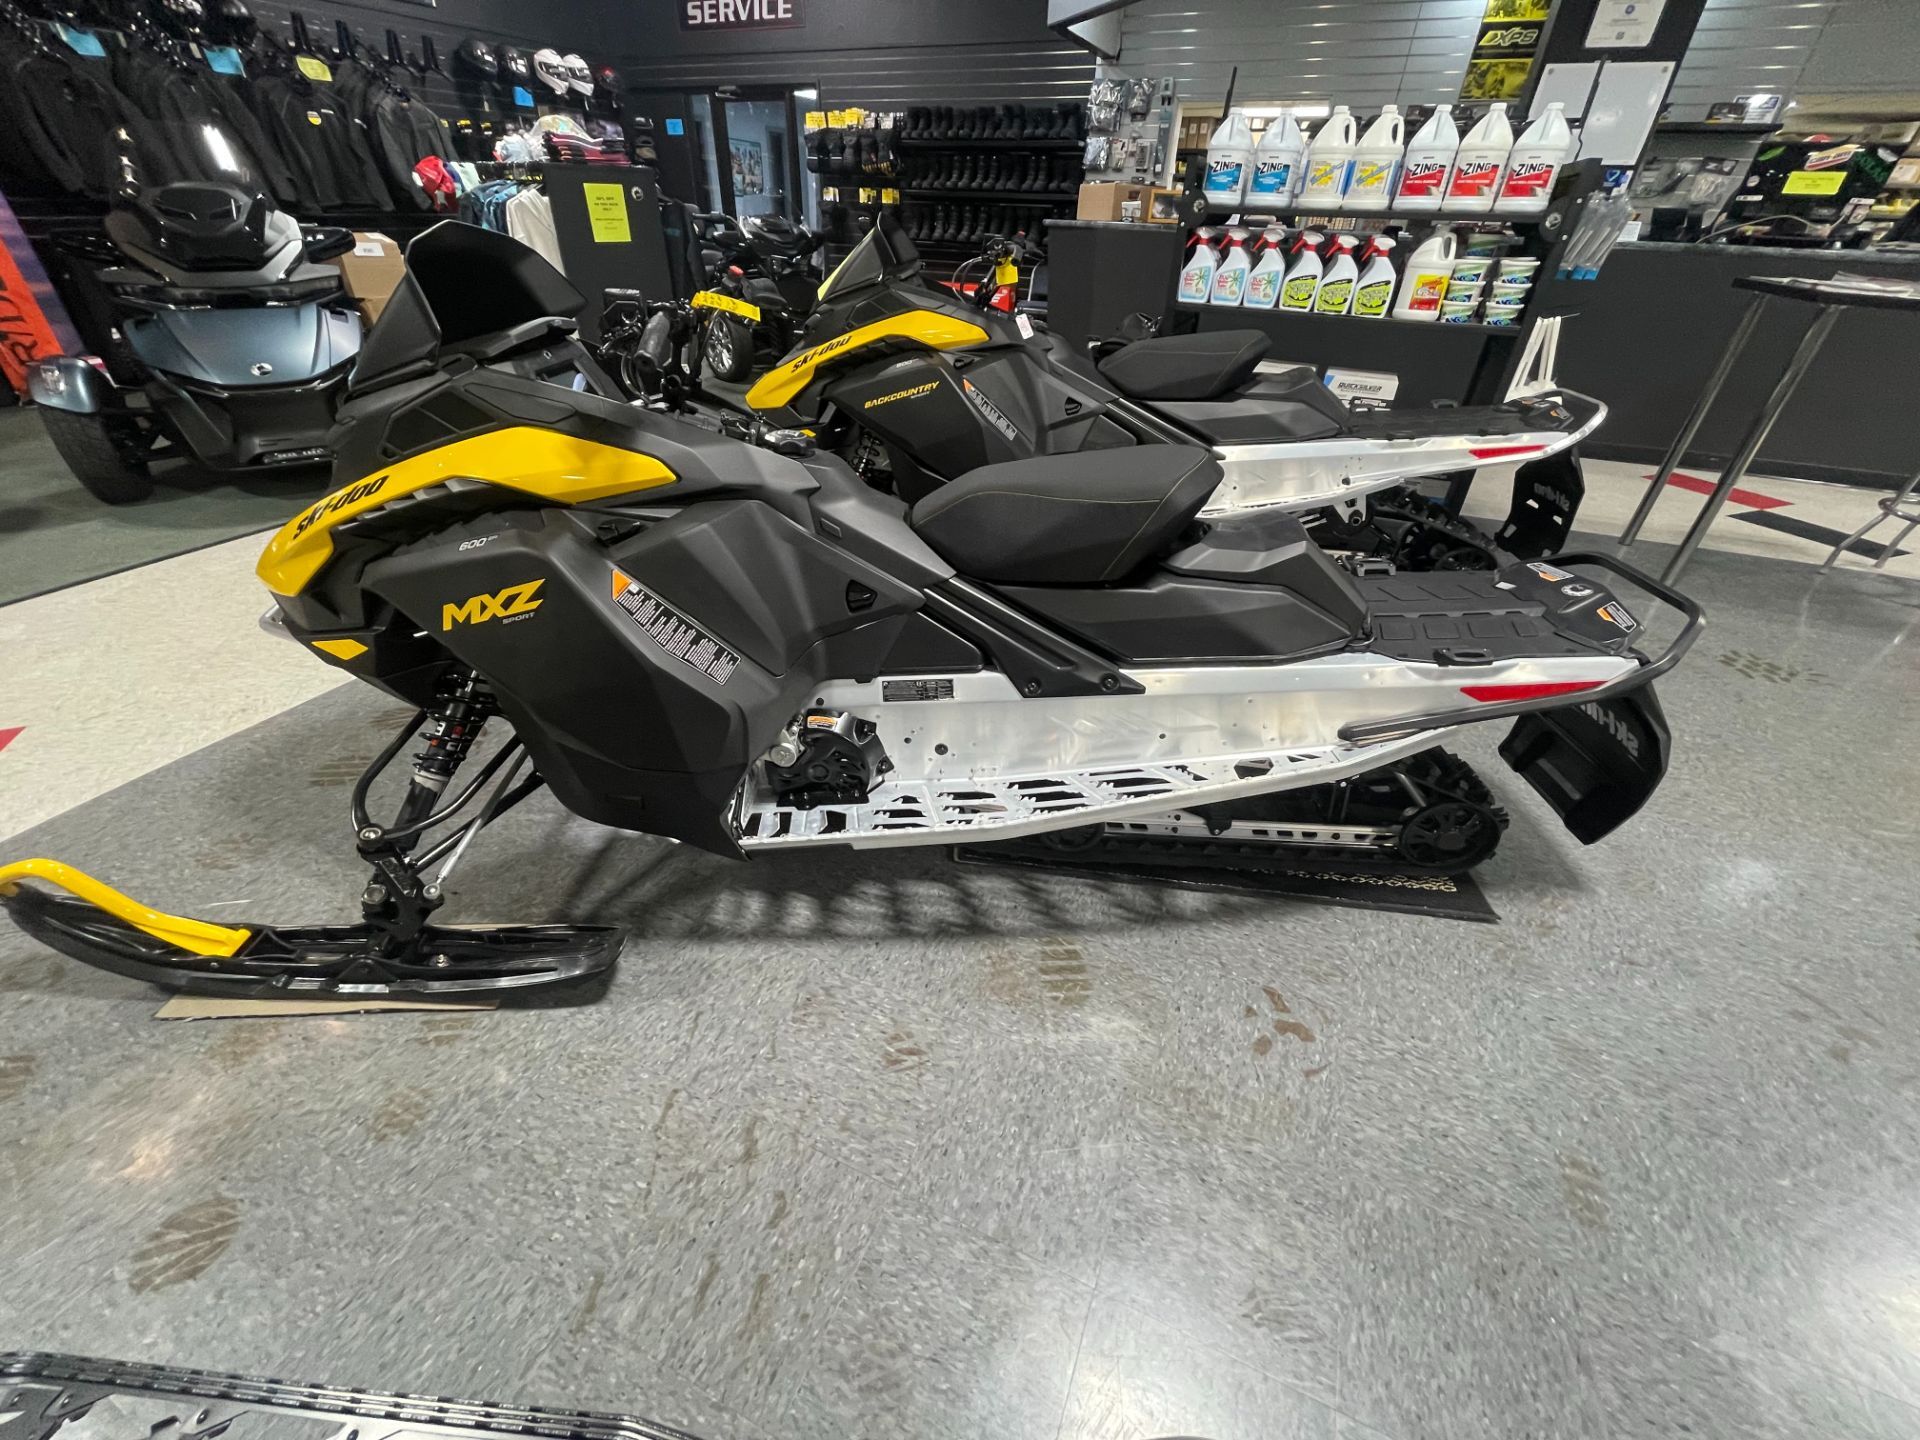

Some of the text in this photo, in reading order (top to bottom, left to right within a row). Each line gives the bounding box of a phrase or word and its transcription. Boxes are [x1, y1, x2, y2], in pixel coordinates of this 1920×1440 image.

[687, 0, 793, 24] SERVICE
[1494, 26, 1539, 46] XPS
[1212, 161, 1236, 173] ZING
[1259, 162, 1283, 174] ZING
[1411, 163, 1438, 176] ZING
[1462, 163, 1491, 176] ZING
[1515, 163, 1545, 176] ZING
[1338, 382, 1382, 392] QUICKSILVER
[864, 381, 939, 409] BACKCOUNTRY
[459, 538, 487, 551] 600
[443, 579, 546, 631] MXZ
[502, 612, 535, 625] SPORT
